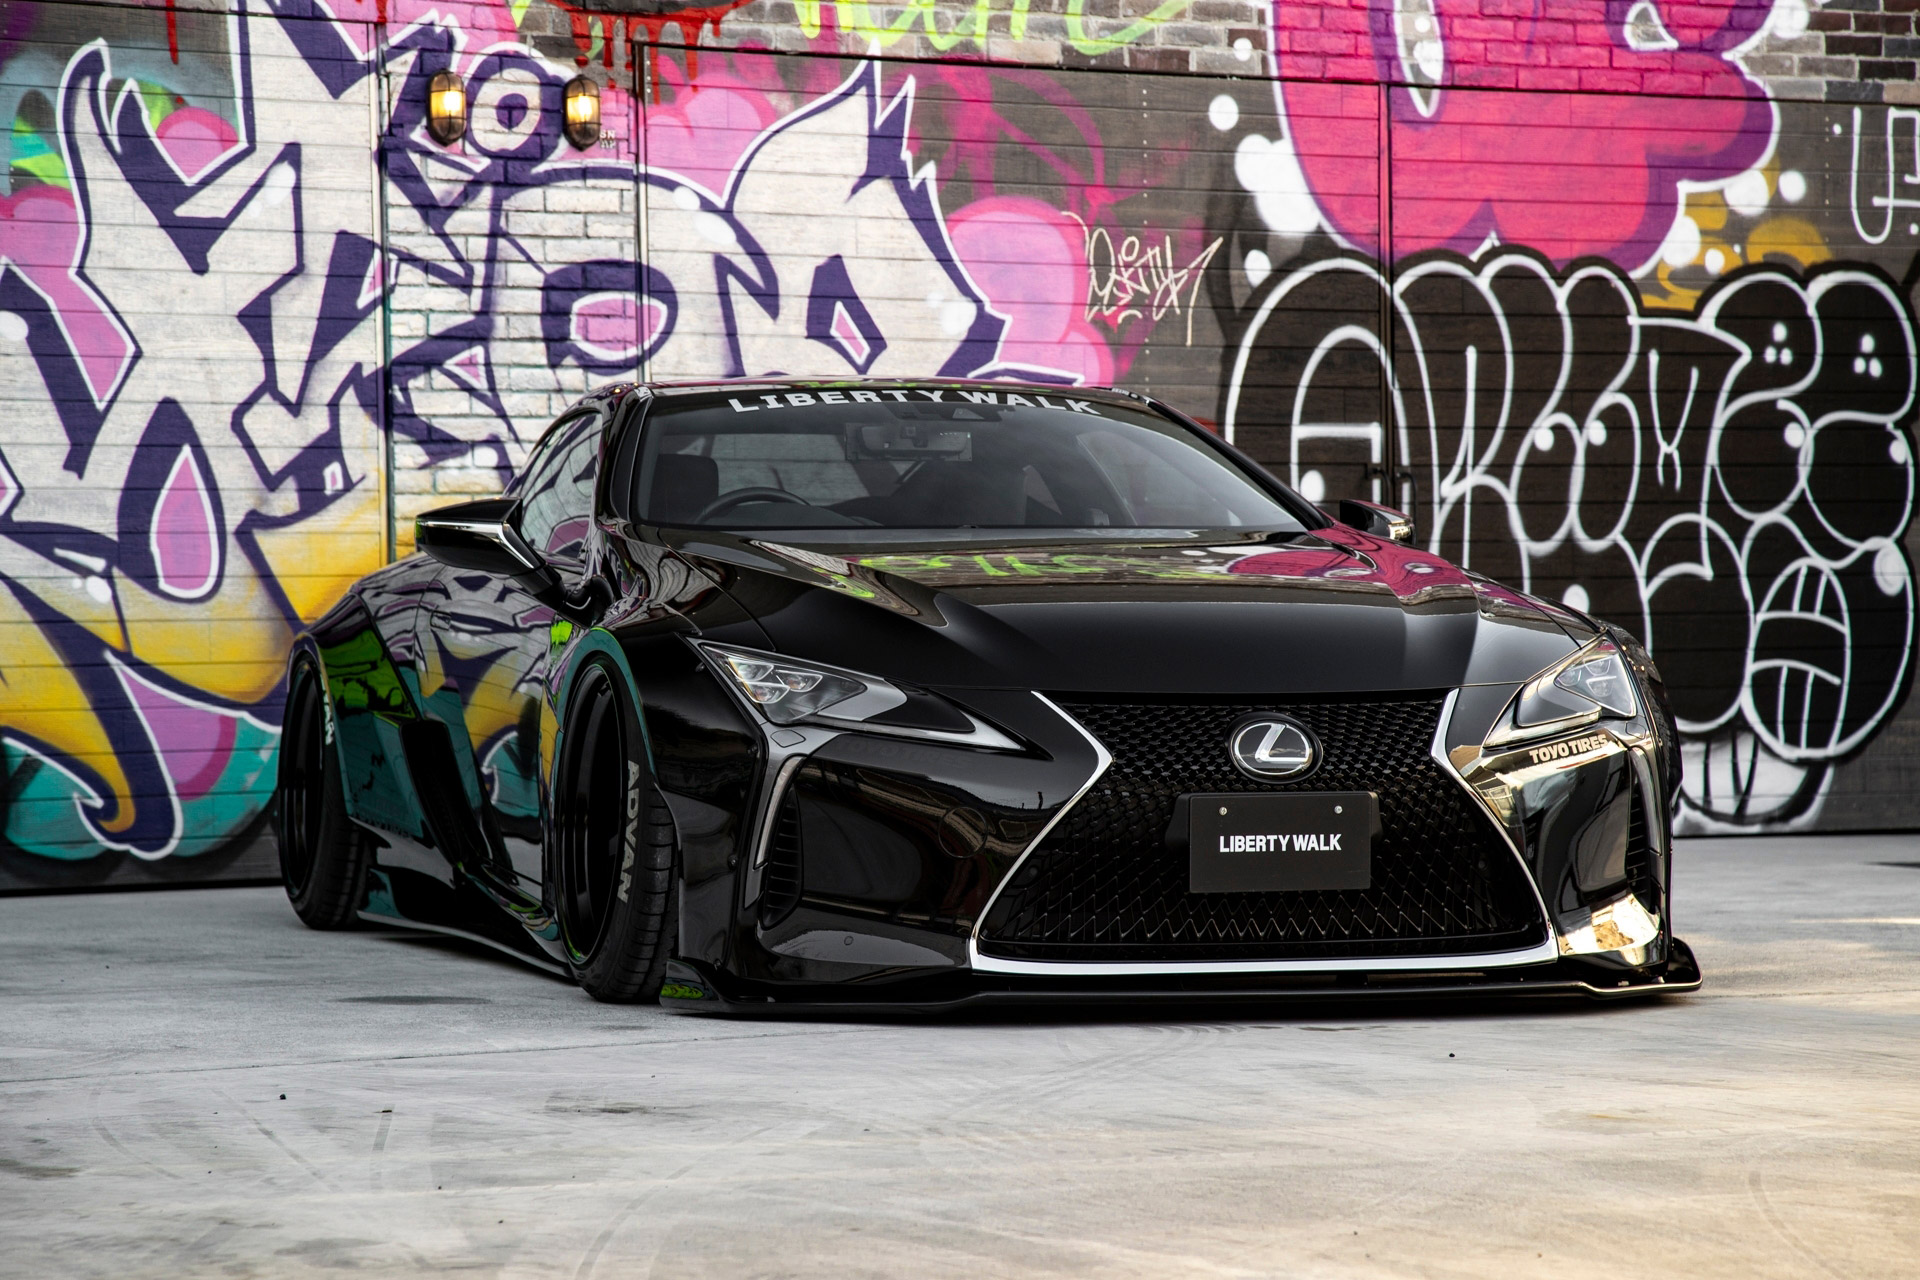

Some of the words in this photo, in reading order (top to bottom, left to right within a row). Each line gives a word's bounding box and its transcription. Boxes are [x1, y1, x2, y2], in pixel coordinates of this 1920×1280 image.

[728, 389, 948, 413] LIBERTY
[959, 390, 1101, 416] WALK
[1529, 744, 1570, 763] TOYO
[1568, 734, 1607, 754] TIRES
[617, 760, 640, 904] ADVAN
[1219, 834, 1290, 853] LIBERTY
[1292, 833, 1341, 851] WALK
